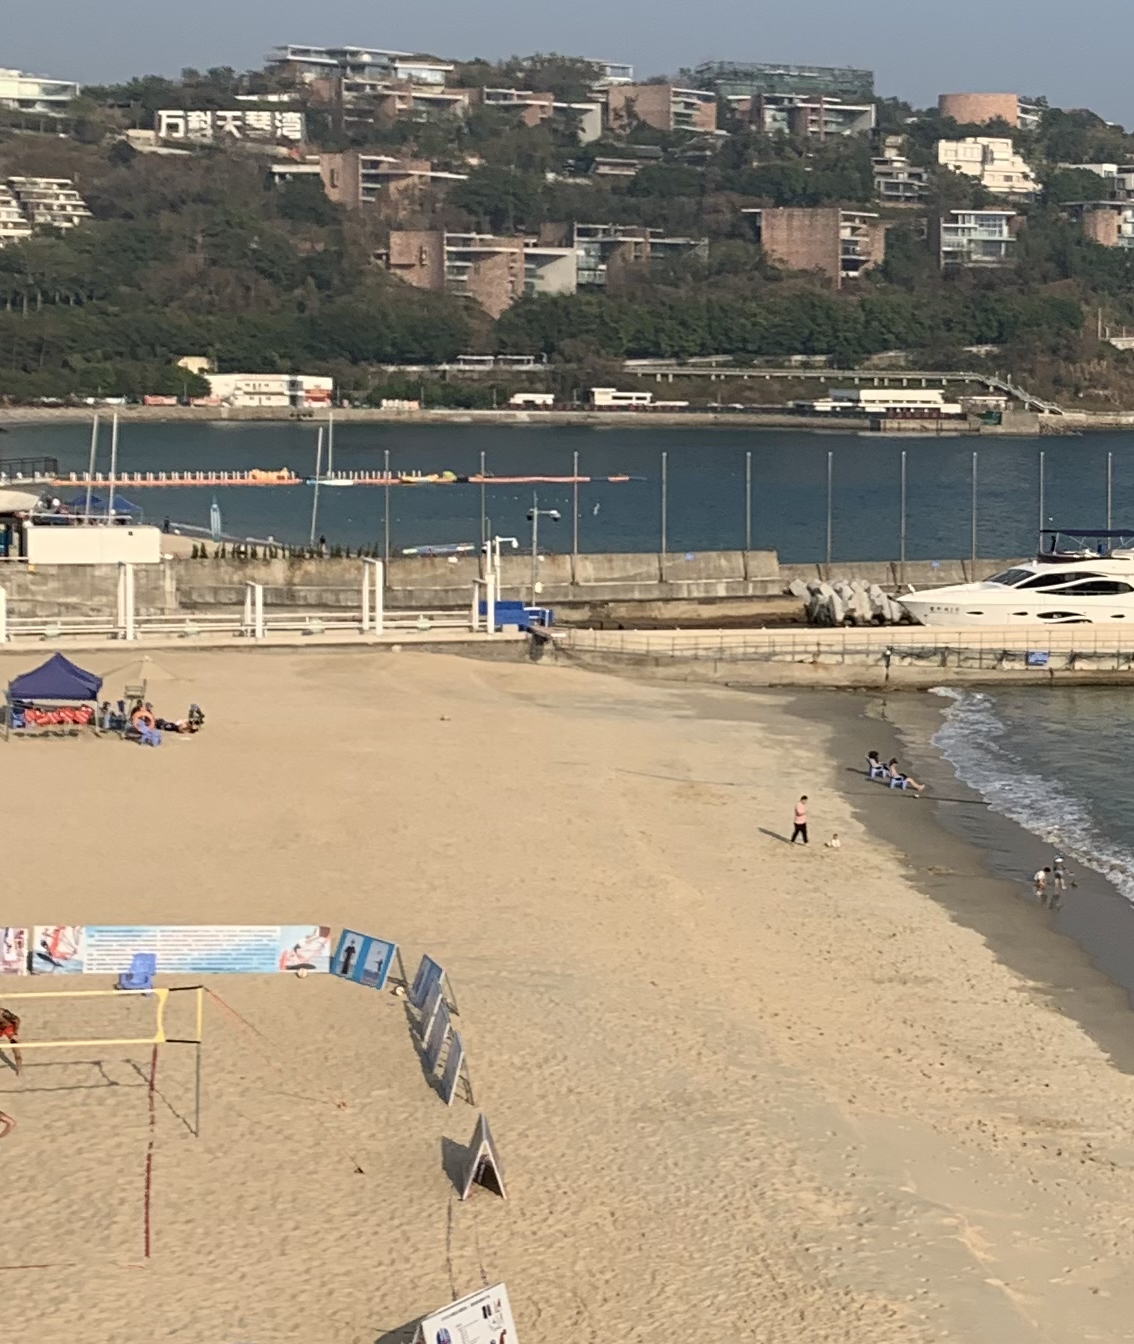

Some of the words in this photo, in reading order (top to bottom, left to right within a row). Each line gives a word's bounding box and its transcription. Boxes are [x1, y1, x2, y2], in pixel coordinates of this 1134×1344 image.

[158, 110, 301, 139] 万科天琴湾
